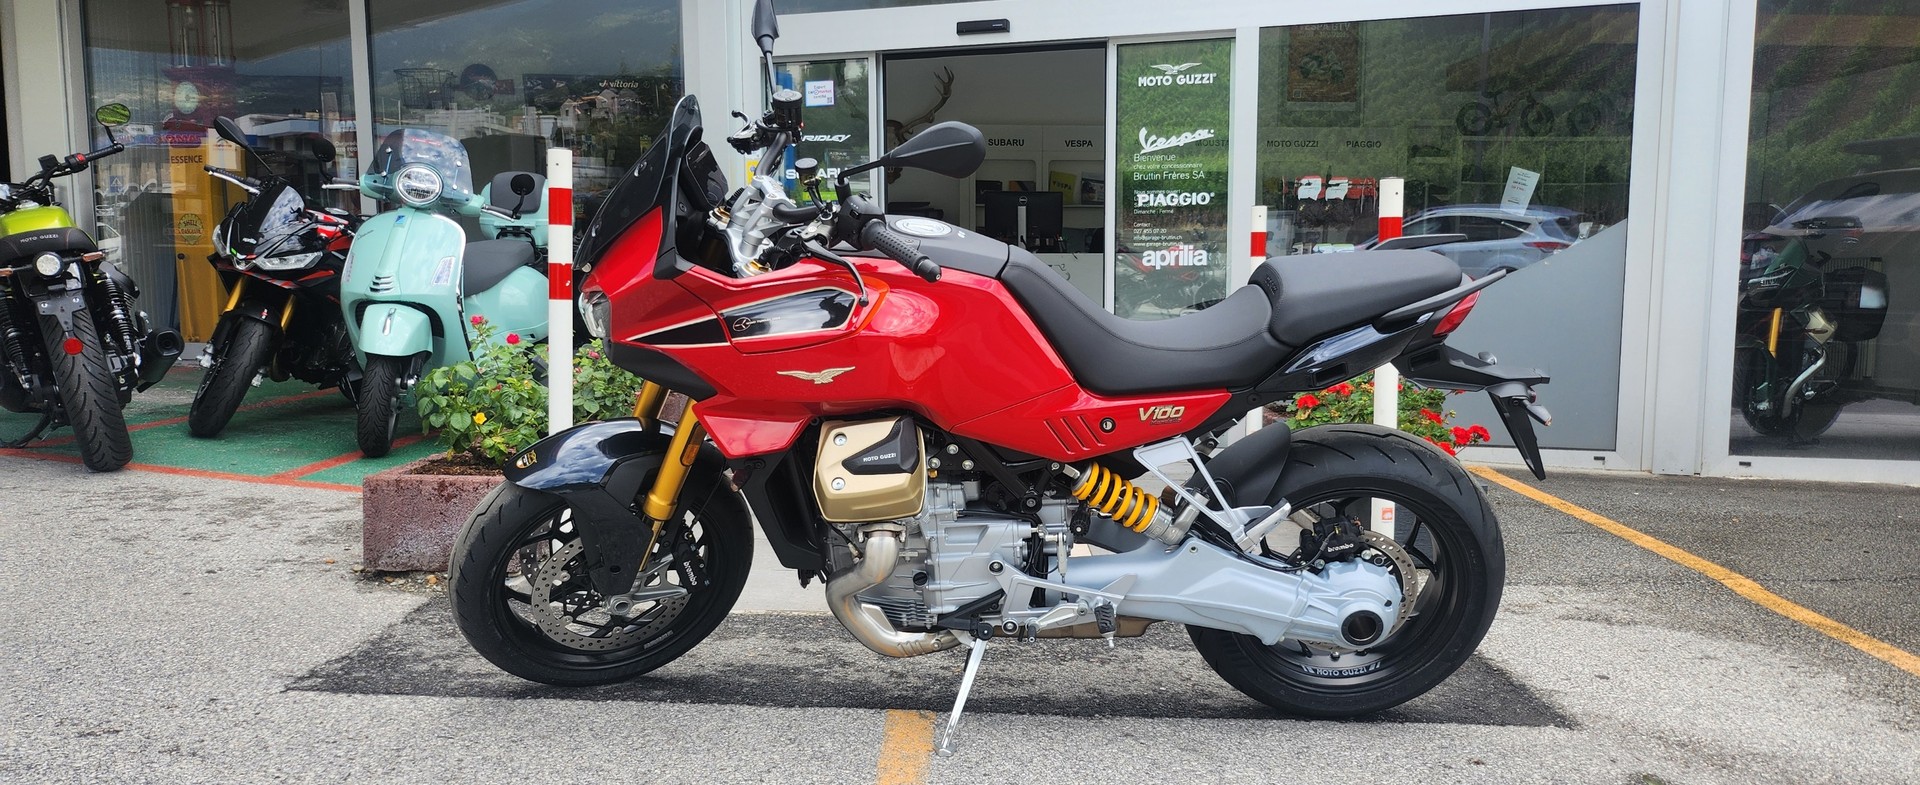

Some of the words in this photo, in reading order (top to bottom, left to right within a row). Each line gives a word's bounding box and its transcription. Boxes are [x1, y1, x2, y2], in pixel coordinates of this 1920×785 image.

[609, 80, 639, 88] vittoria
[1138, 76, 1172, 87] MOTO
[801, 134, 851, 142] RIDLEY
[1138, 127, 1215, 154] Vespa
[988, 139, 1024, 147] SUBARU
[1065, 140, 1093, 148] VESPA
[1266, 140, 1292, 148] MOTO
[1294, 140, 1319, 148] GUZZI
[1346, 140, 1381, 148] PIAGGIO
[171, 155, 203, 163] ESSENCE
[1133, 153, 1176, 162] Bienvenue
[785, 167, 849, 179] SAR
[1133, 172, 1160, 181] Bruttin
[1163, 170, 1190, 180] Frères
[1192, 170, 1205, 179] SA
[1137, 192, 1211, 207] PIAGGIO
[1142, 244, 1208, 270] aprilia
[1138, 406, 1185, 421] V100
[1327, 543, 1354, 552] brembo
[683, 560, 697, 585] brembo
[1316, 668, 1340, 676] MOTO
[1341, 667, 1367, 676] GUZZI
